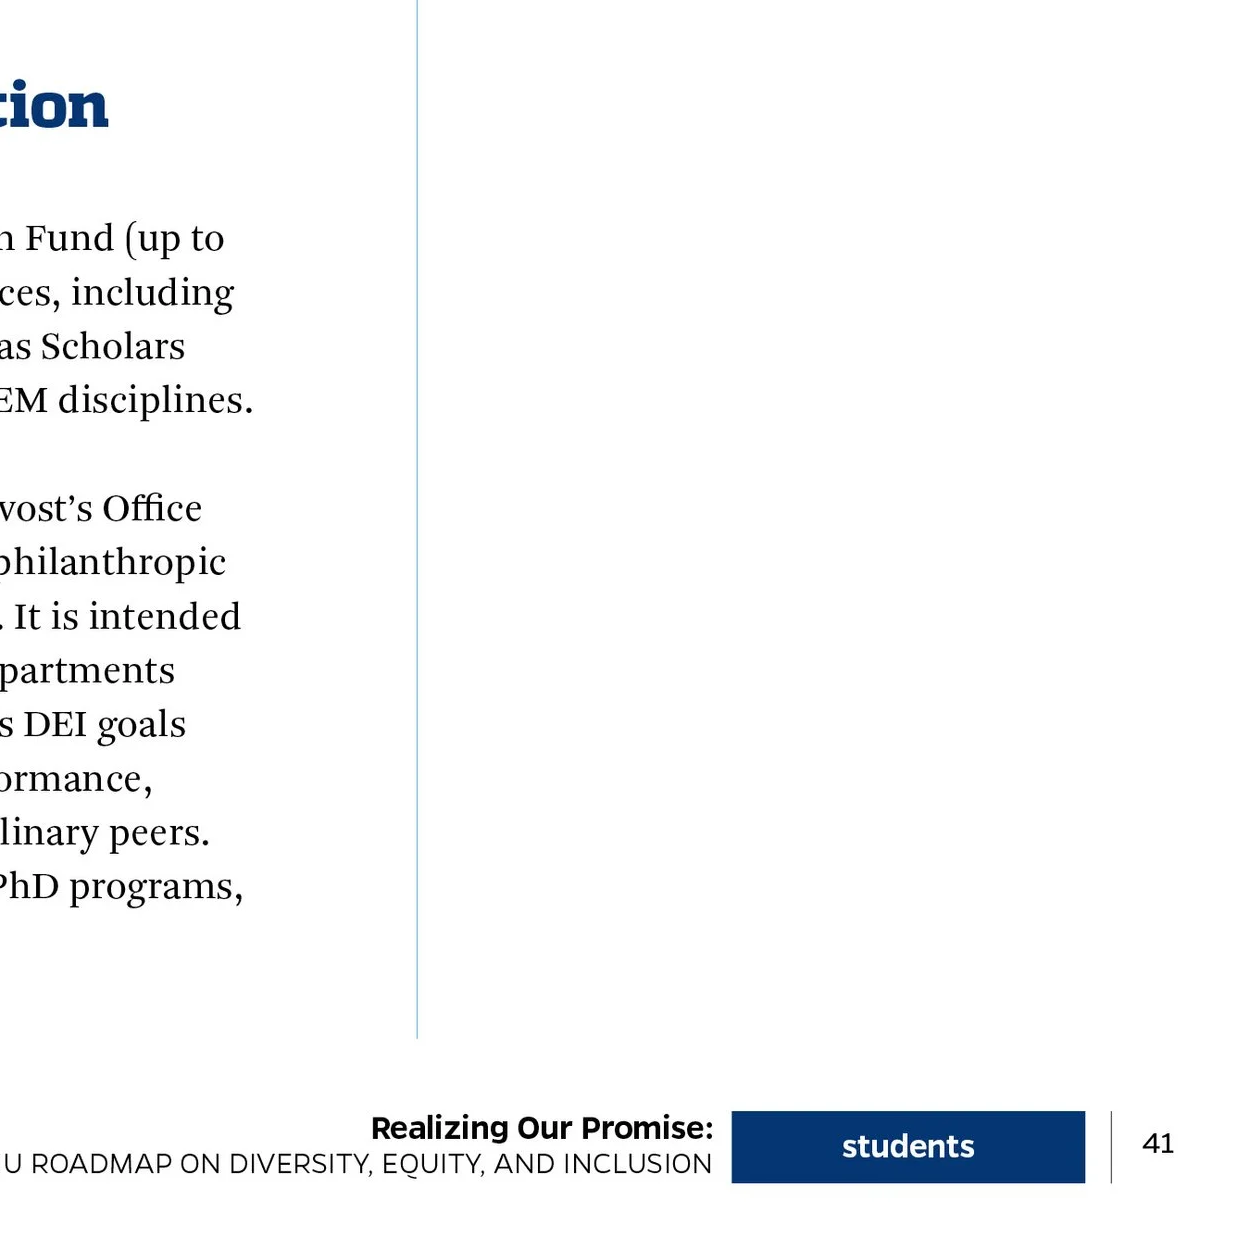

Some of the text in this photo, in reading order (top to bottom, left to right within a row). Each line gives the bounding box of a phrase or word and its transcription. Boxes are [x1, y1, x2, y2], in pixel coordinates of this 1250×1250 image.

[25, 221, 115, 252] Fund
[125, 220, 181, 261] (up
[190, 225, 225, 252] to
[71, 276, 235, 316] including
[41, 330, 185, 361] Scholars
[58, 383, 253, 423] disciplines.
[102, 491, 202, 523] Office
[14, 603, 42, 631] It
[51, 600, 79, 631] is
[89, 600, 242, 631] intended
[23, 710, 87, 737] DEI
[96, 708, 186, 747] goals
[109, 825, 209, 855] peers.
[69, 878, 243, 910] programs,
[372, 1113, 713, 1145] Realizing Our Promise:
[1141, 1132, 1175, 1154] 41
[841, 1132, 975, 1159] students
[32, 1152, 172, 1174] ROADMAP
[180, 1152, 220, 1174] ON
[230, 1152, 373, 1178] DIVERSITY,
[383, 1152, 485, 1180] EQUITY,
[493, 1152, 555, 1174] AND
[565, 1152, 711, 1174] INCLUSION
